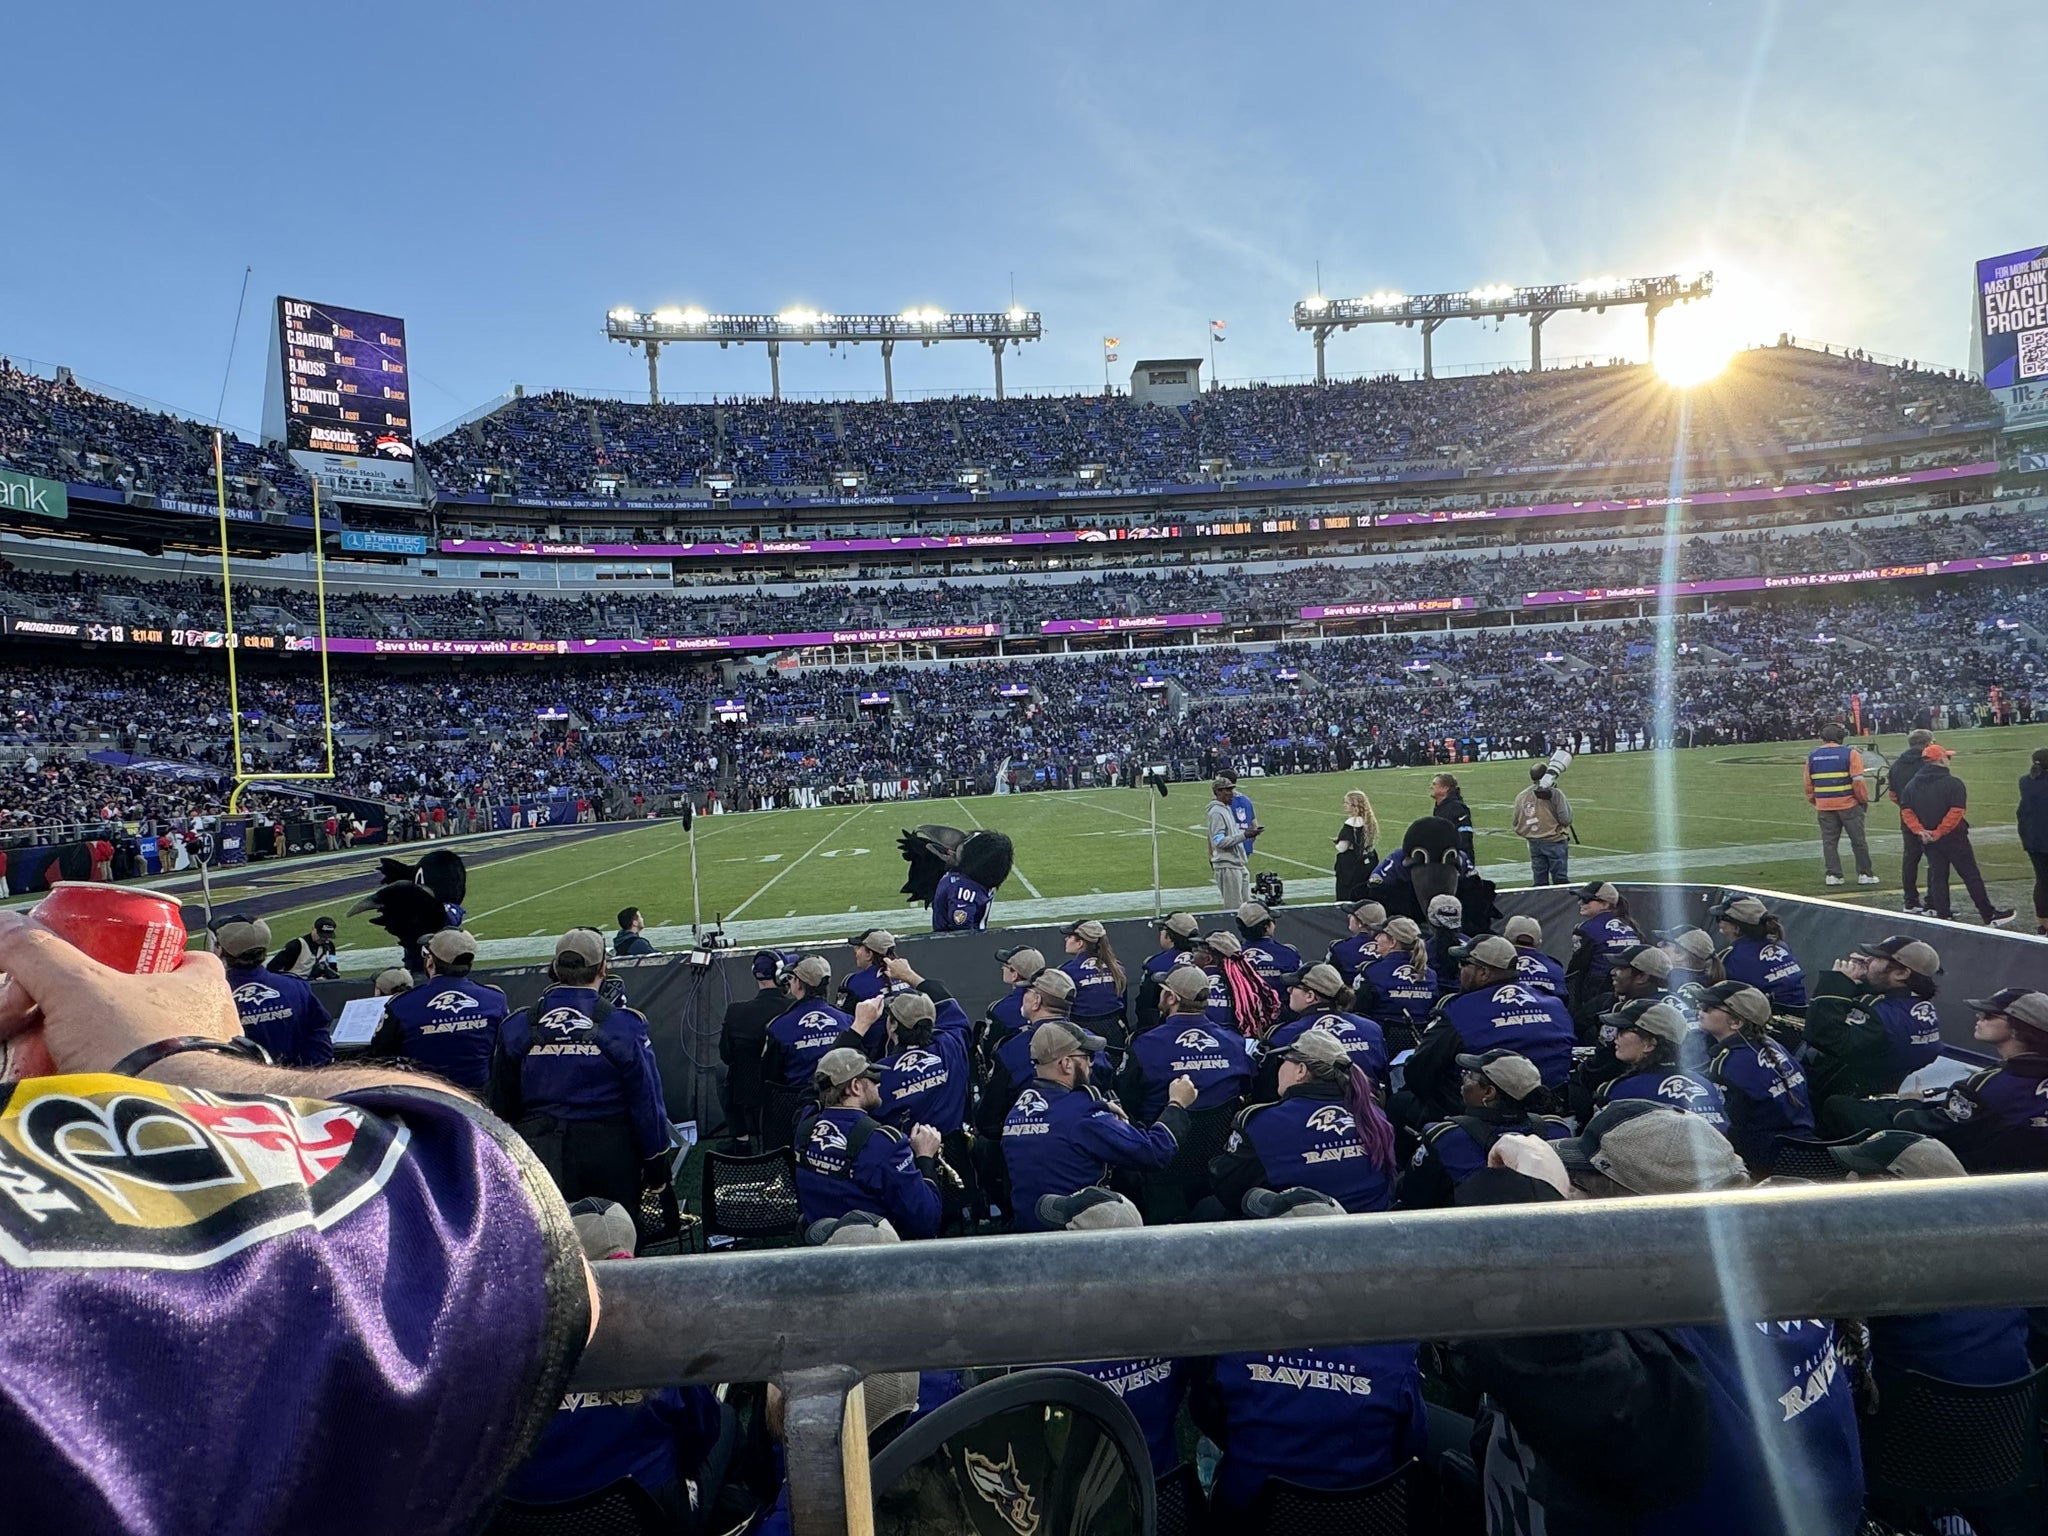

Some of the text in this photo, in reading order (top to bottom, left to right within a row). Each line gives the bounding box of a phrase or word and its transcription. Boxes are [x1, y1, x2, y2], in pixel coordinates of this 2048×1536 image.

[1995, 266, 2008, 279] FOR
[2010, 262, 2030, 275] MORE
[1984, 270, 2047, 295] M&T BANK
[1985, 283, 2047, 315] EVACU
[285, 301, 311, 319] D.KEY
[1987, 304, 2048, 335] PROCE
[286, 316, 292, 329] 5
[333, 324, 338, 336] 3
[380, 333, 386, 345] 0
[287, 330, 333, 351] C.BARTON
[289, 345, 293, 357] 1
[335, 352, 340, 364] 6
[382, 360, 388, 371] 0
[288, 358, 326, 377] R.MOSS
[290, 373, 296, 385] 3
[336, 380, 342, 391] 2
[384, 387, 390, 399] 0
[291, 386, 339, 406] N.BONITTO
[292, 401, 298, 413] 3
[339, 408, 344, 419] 1
[386, 414, 392, 425] 0
[325, 466, 386, 478] MedStar Health
[161, 499, 176, 509] TEXT
[518, 498, 547, 506] MARSHAL
[1212, 524, 1220, 535] 10
[1324, 516, 1370, 529] TIMEOUT 1:22
[364, 534, 420, 544] STRATEGIC
[365, 542, 420, 552] FACTORY
[1791, 576, 1807, 585] the
[1809, 575, 1826, 584] E-Z
[1828, 574, 1850, 583] way
[1853, 570, 1877, 580] with
[1880, 567, 1924, 576] E-ZPass
[1346, 606, 1361, 614] the
[1363, 605, 1377, 613] E-Z
[1378, 604, 1396, 614] way
[1397, 602, 1416, 611] with
[1418, 601, 1451, 609] E-ZPass
[15, 621, 80, 635] PROGRESSIVE
[111, 626, 123, 642] 13
[859, 632, 876, 640] the
[879, 631, 896, 639] E-Z
[897, 630, 918, 640] way
[920, 628, 942, 637] with
[944, 628, 982, 636] E-ZPass
[147, 630, 162, 642] 4TH
[171, 630, 184, 645] 27
[260, 636, 274, 648] 4TH
[376, 640, 556, 653] $ave the E-Z way with E-ZPass
[958, 887, 975, 903] 101
[1702, 894, 1708, 902] 2
[1388, 990, 1432, 999] RAVENS
[241, 1008, 293, 1026] AVENS
[242, 1005, 284, 1015] ALTIMORE
[420, 1018, 488, 1035] RAVENS
[432, 1015, 482, 1024] BALTIMORE
[1491, 1014, 1552, 1028] RAVENS
[528, 1044, 601, 1056] RAVENS
[1343, 1042, 1369, 1052] ENS
[1170, 1059, 1229, 1071] RAVENS
[892, 1071, 949, 1100] RAVEN
[1002, 1123, 1050, 1136] RAVENS
[806, 1151, 845, 1166] ALTIMORE
[1301, 1145, 1367, 1164] RAVEN
[1267, 1355, 1356, 1372] BALTIMORE
[1247, 1364, 1371, 1396] RAVENS
